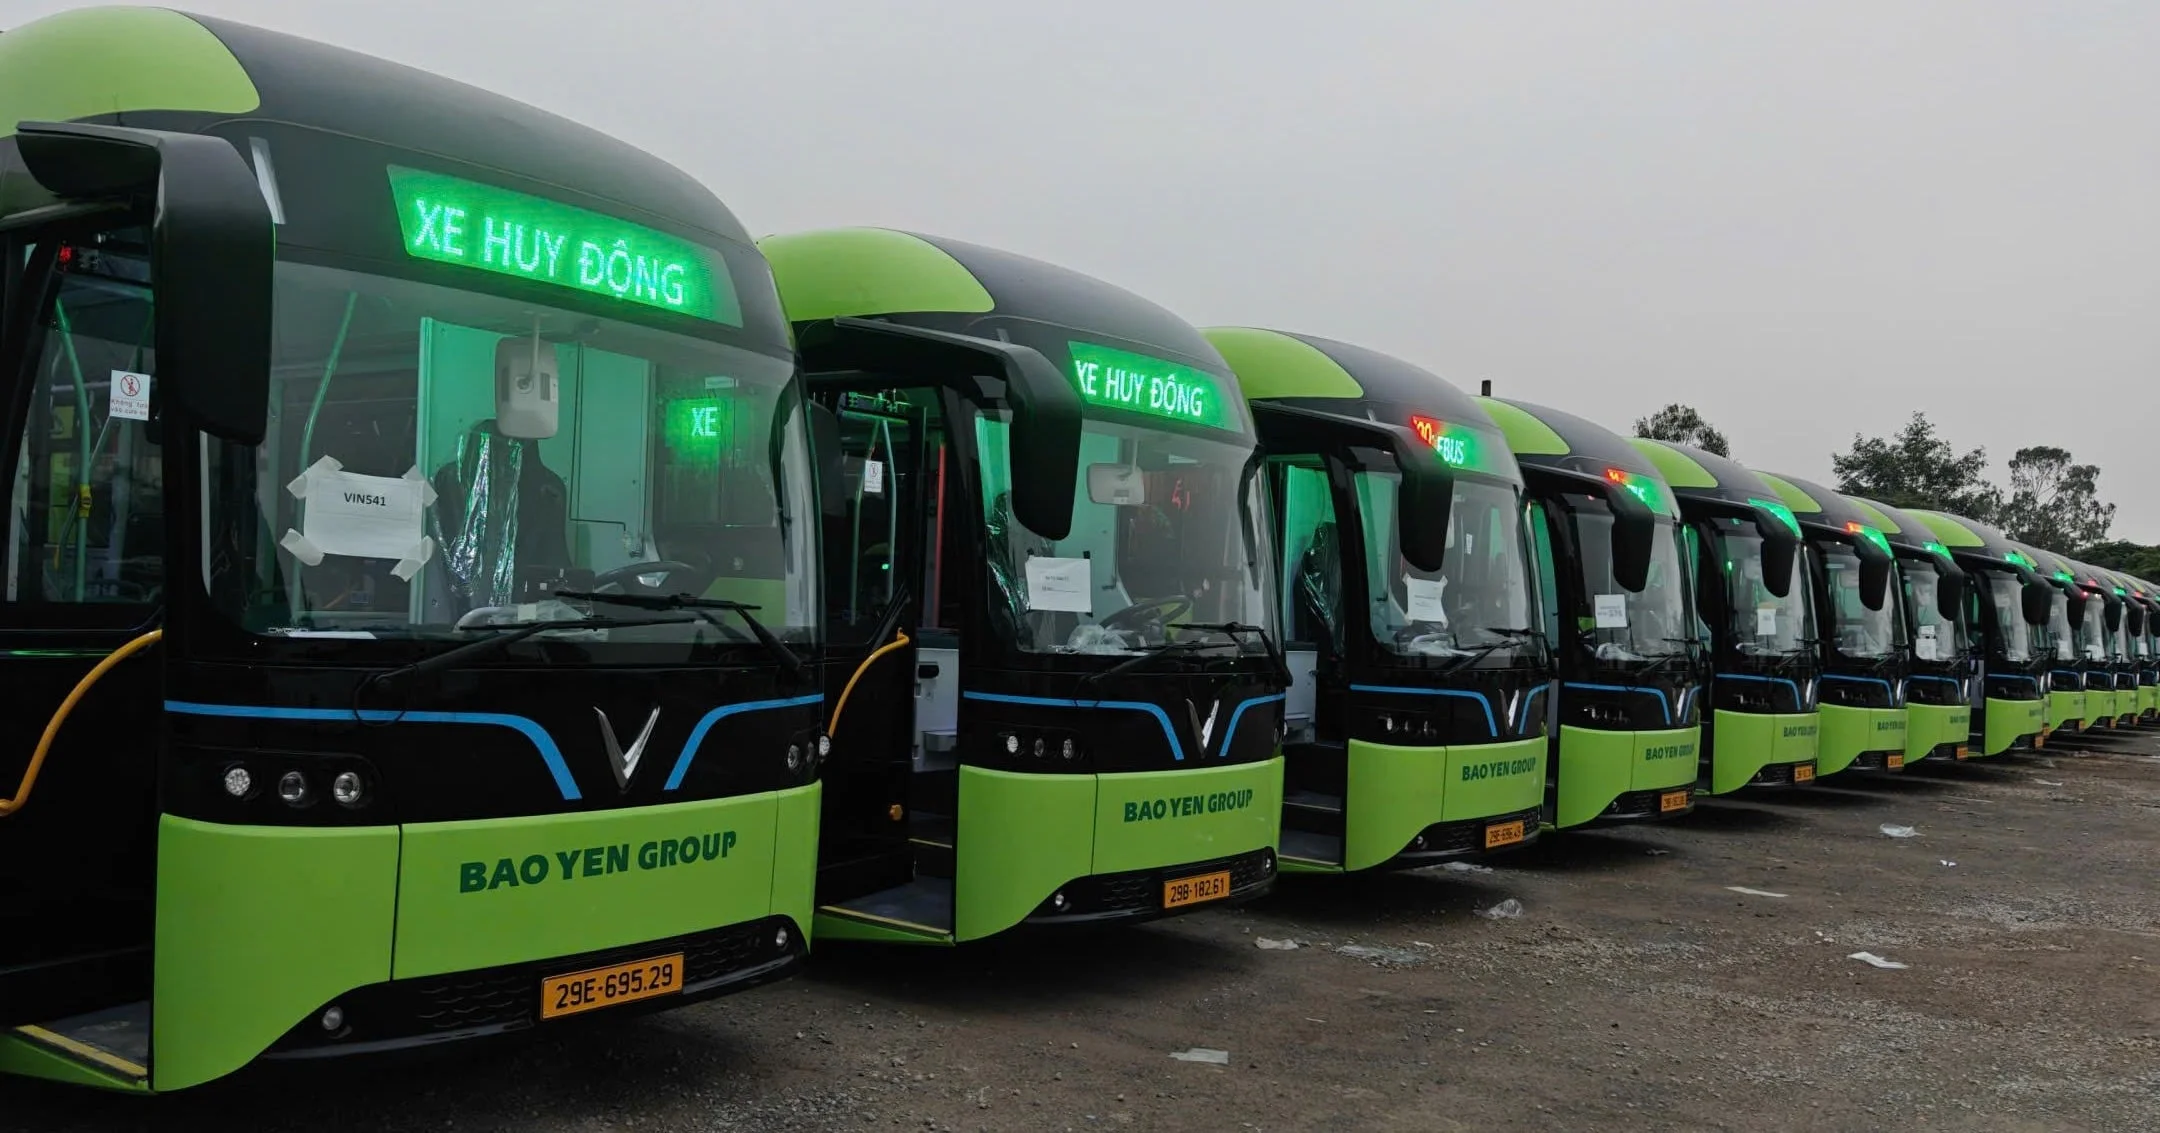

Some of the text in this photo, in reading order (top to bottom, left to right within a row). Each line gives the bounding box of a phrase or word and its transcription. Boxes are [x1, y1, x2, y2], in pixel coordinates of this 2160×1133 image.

[415, 199, 685, 305] XE HUY ĐỘNG
[1075, 360, 1204, 417] XE HUY ĐỘNG
[691, 406, 719, 437] XE
[343, 492, 387, 507] VIN541
[1462, 757, 1536, 781] BAO YEN GROUP
[1645, 748, 1664, 761] BAO
[1665, 745, 1678, 759] YEN
[1123, 789, 1253, 822] BAO YEN GROUP
[459, 830, 737, 893] BAO YEN GROUP
[554, 963, 674, 1010] 29E-695.29
